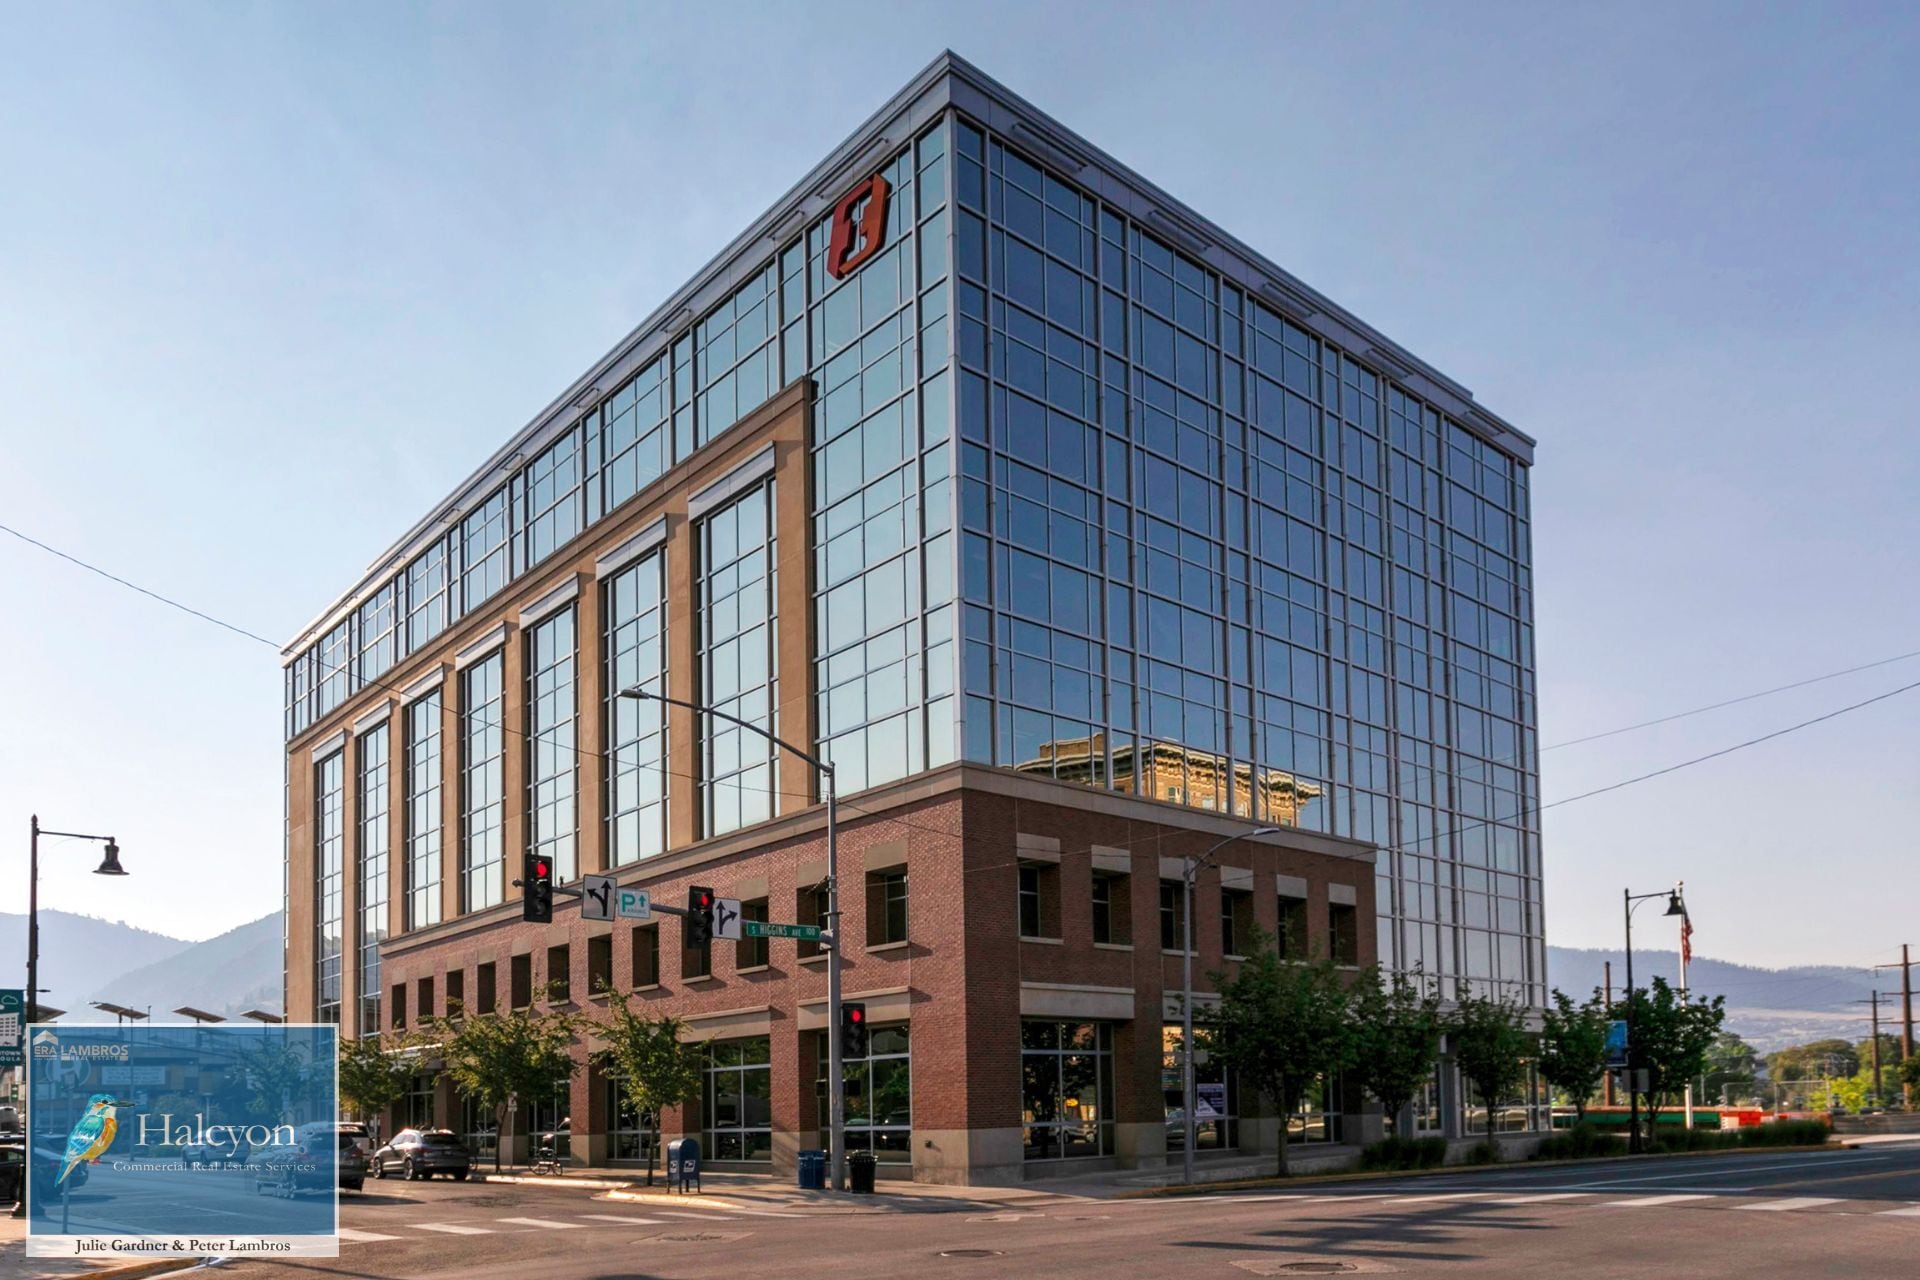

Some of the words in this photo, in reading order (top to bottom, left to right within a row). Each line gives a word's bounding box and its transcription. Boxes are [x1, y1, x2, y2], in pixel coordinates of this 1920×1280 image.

[751, 925, 756, 935] S
[760, 924, 787, 936] HIGGINS
[792, 928, 801, 937] AVE
